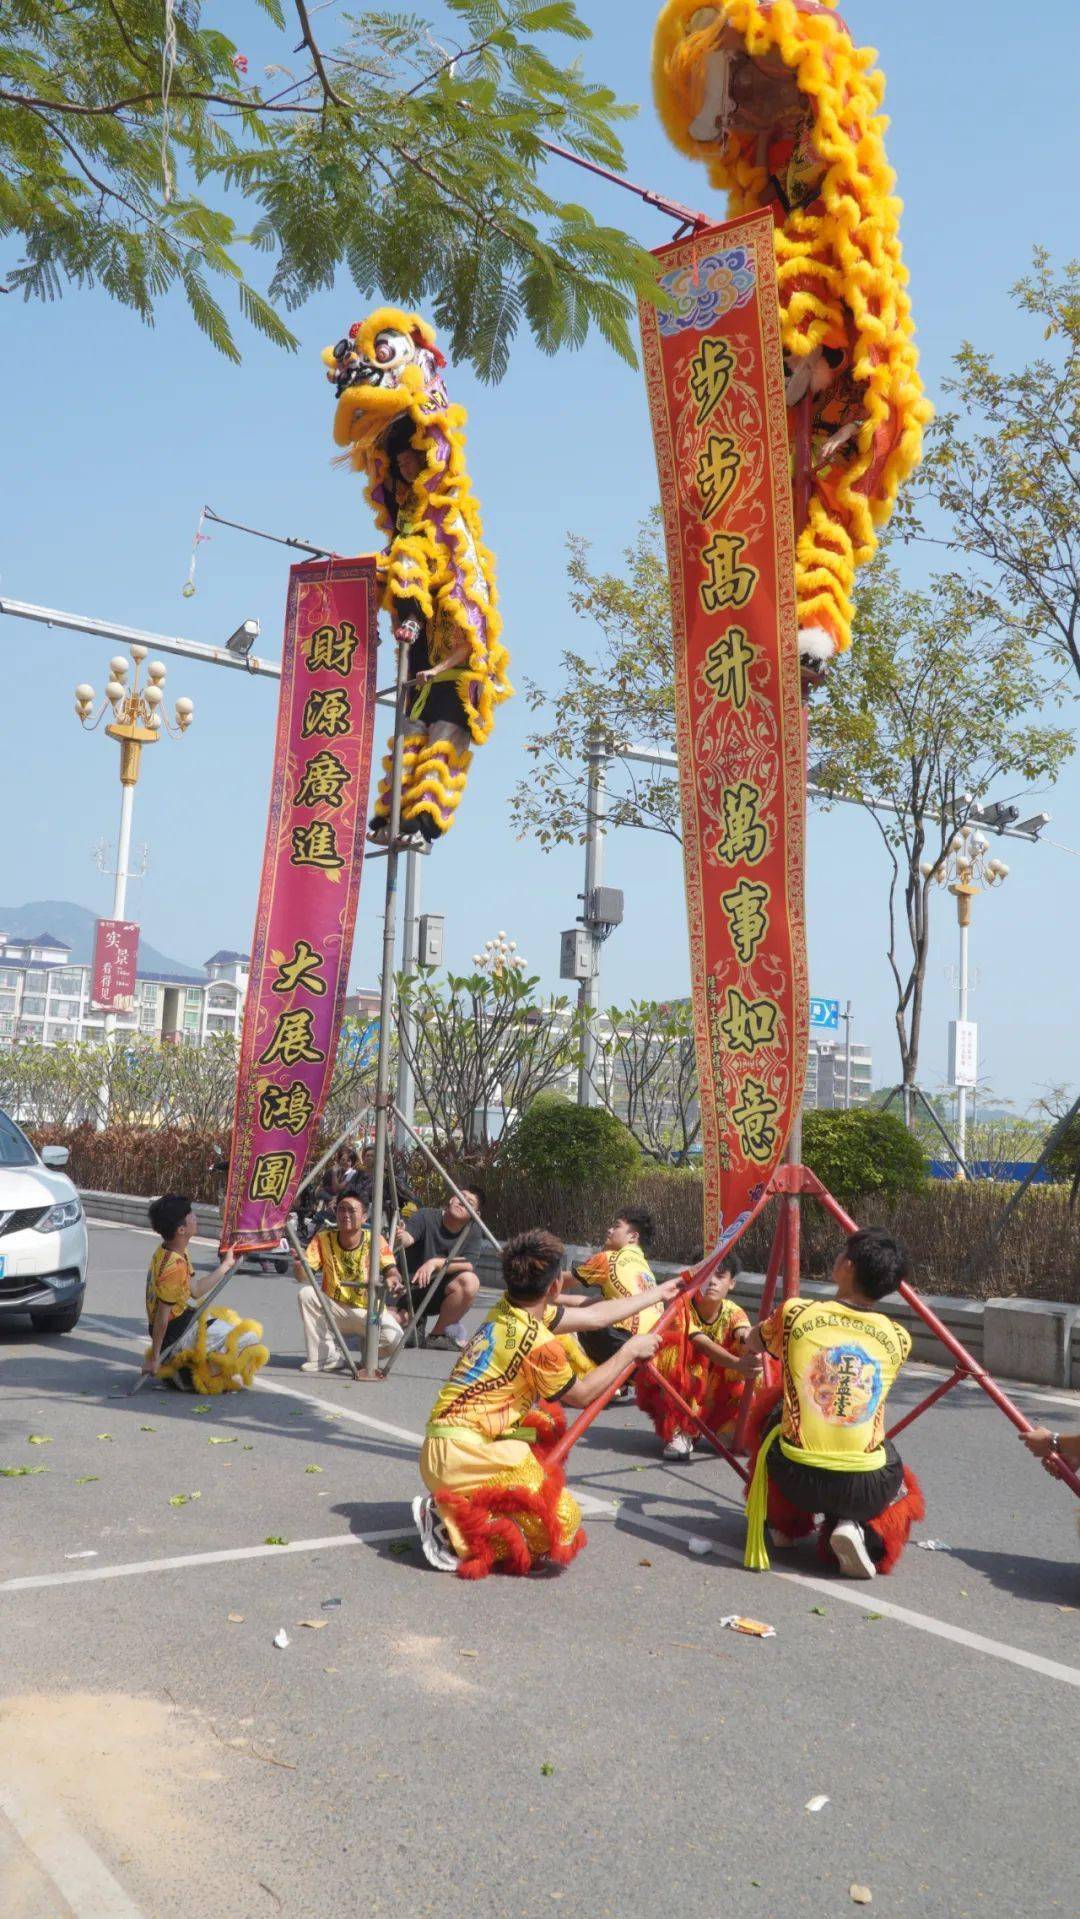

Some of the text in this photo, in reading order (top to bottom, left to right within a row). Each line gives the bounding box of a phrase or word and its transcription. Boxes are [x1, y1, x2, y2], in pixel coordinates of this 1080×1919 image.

[249, 624, 357, 1207] 財源廣進 大展鴻圖
[718, 784, 780, 1160] 萬事如意
[833, 1357, 857, 1417] 正益堂
